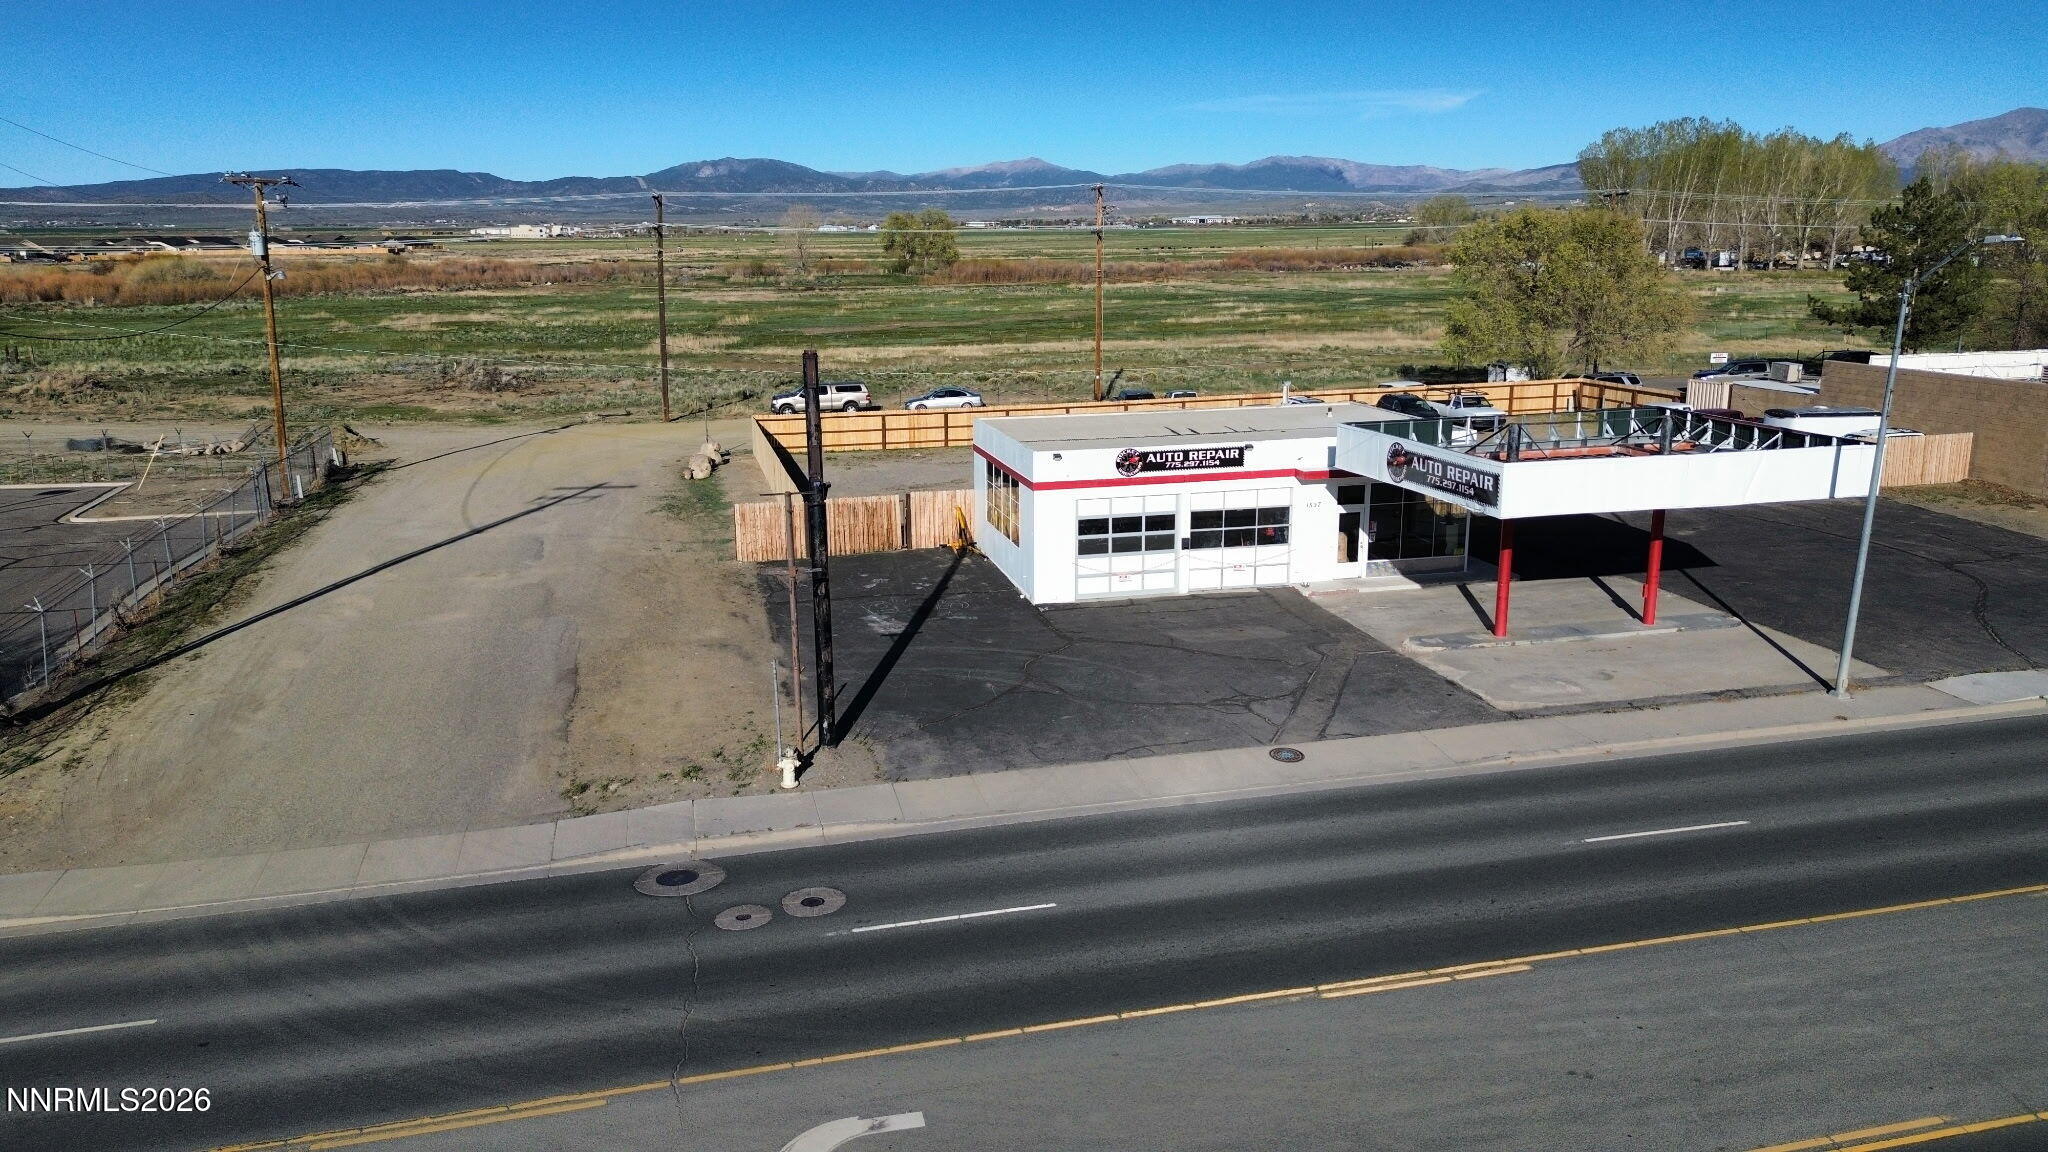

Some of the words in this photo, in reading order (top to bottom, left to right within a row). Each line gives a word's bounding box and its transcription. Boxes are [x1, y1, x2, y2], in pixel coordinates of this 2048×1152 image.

[1146, 453, 1183, 463] AUTO
[1188, 449, 1240, 460] REPAIR
[1165, 459, 1220, 468] 775.297.1154
[1411, 457, 1442, 476] AUTO
[1447, 465, 1493, 491] REPAIR
[1426, 475, 1475, 496] 775.297.1154
